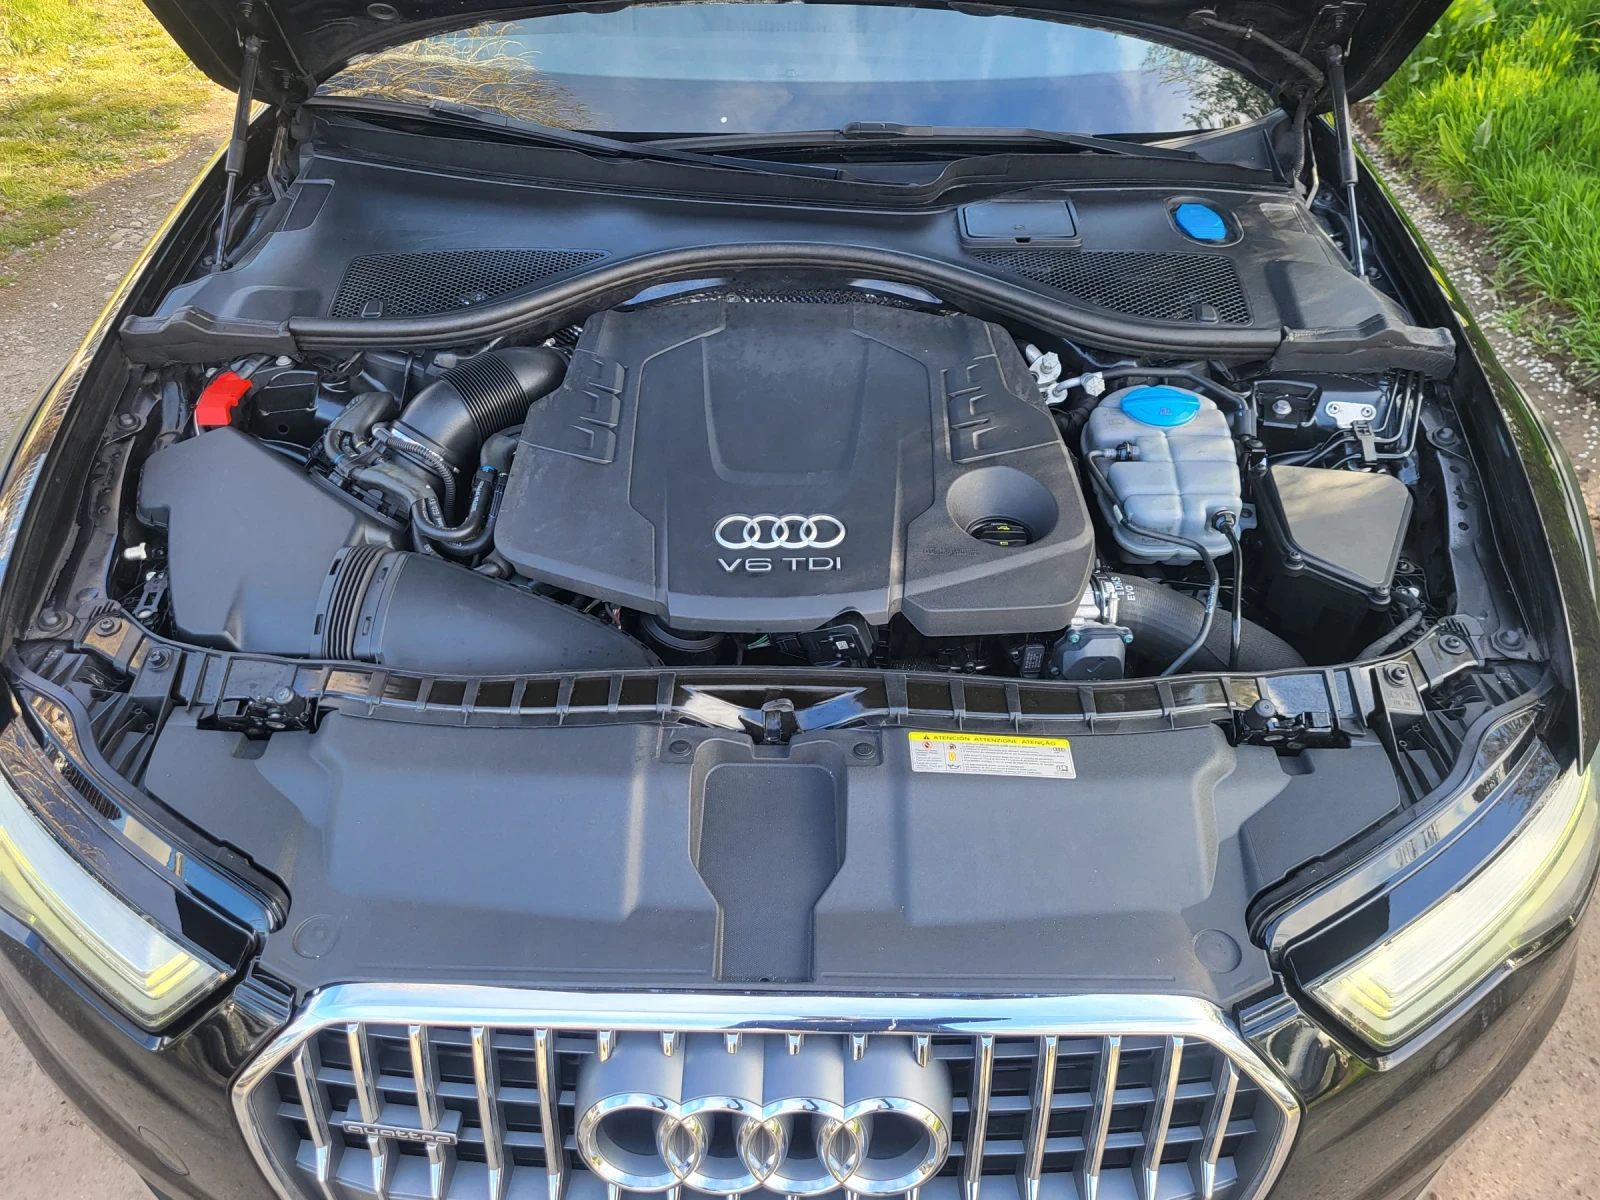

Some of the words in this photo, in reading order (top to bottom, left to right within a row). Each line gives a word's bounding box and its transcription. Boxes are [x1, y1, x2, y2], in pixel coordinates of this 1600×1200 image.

[718, 558, 772, 573] V6
[782, 557, 842, 571] TDI
[1125, 585, 1136, 601] EVO
[1021, 738, 1056, 746] ATENÇÃO
[347, 1125, 451, 1143] quattro
